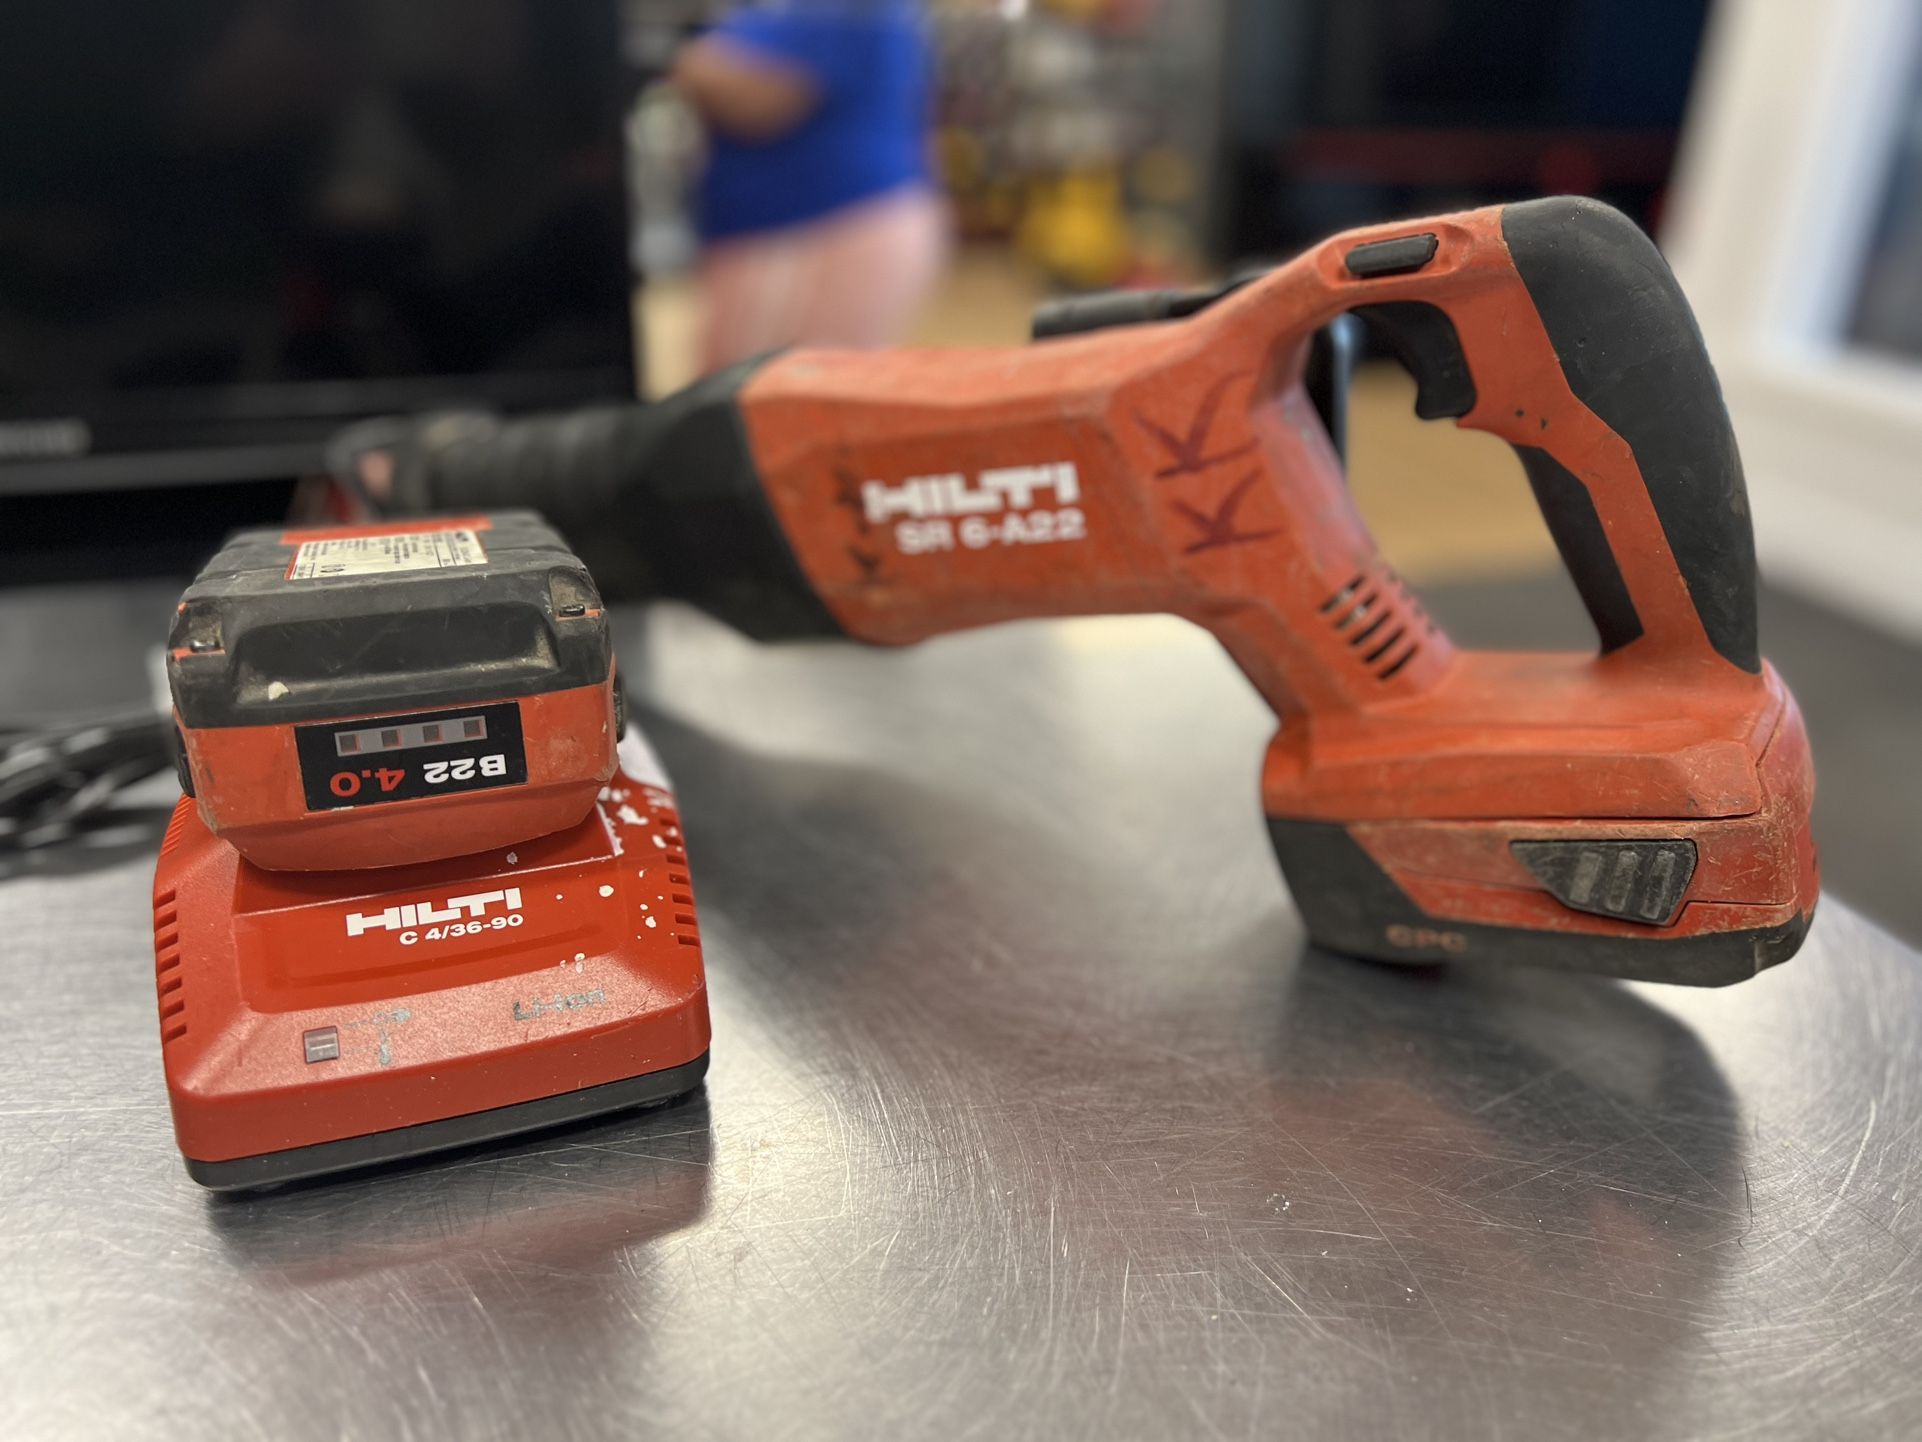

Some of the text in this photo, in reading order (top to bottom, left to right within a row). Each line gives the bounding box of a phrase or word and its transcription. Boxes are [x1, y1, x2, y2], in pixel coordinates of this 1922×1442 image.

[863, 461, 1079, 524] HILTI
[895, 507, 1087, 556] SR 6-A22
[330, 753, 507, 798] B22 4.0
[346, 887, 523, 937] HILTI
[399, 913, 525, 946] C 4/36-90
